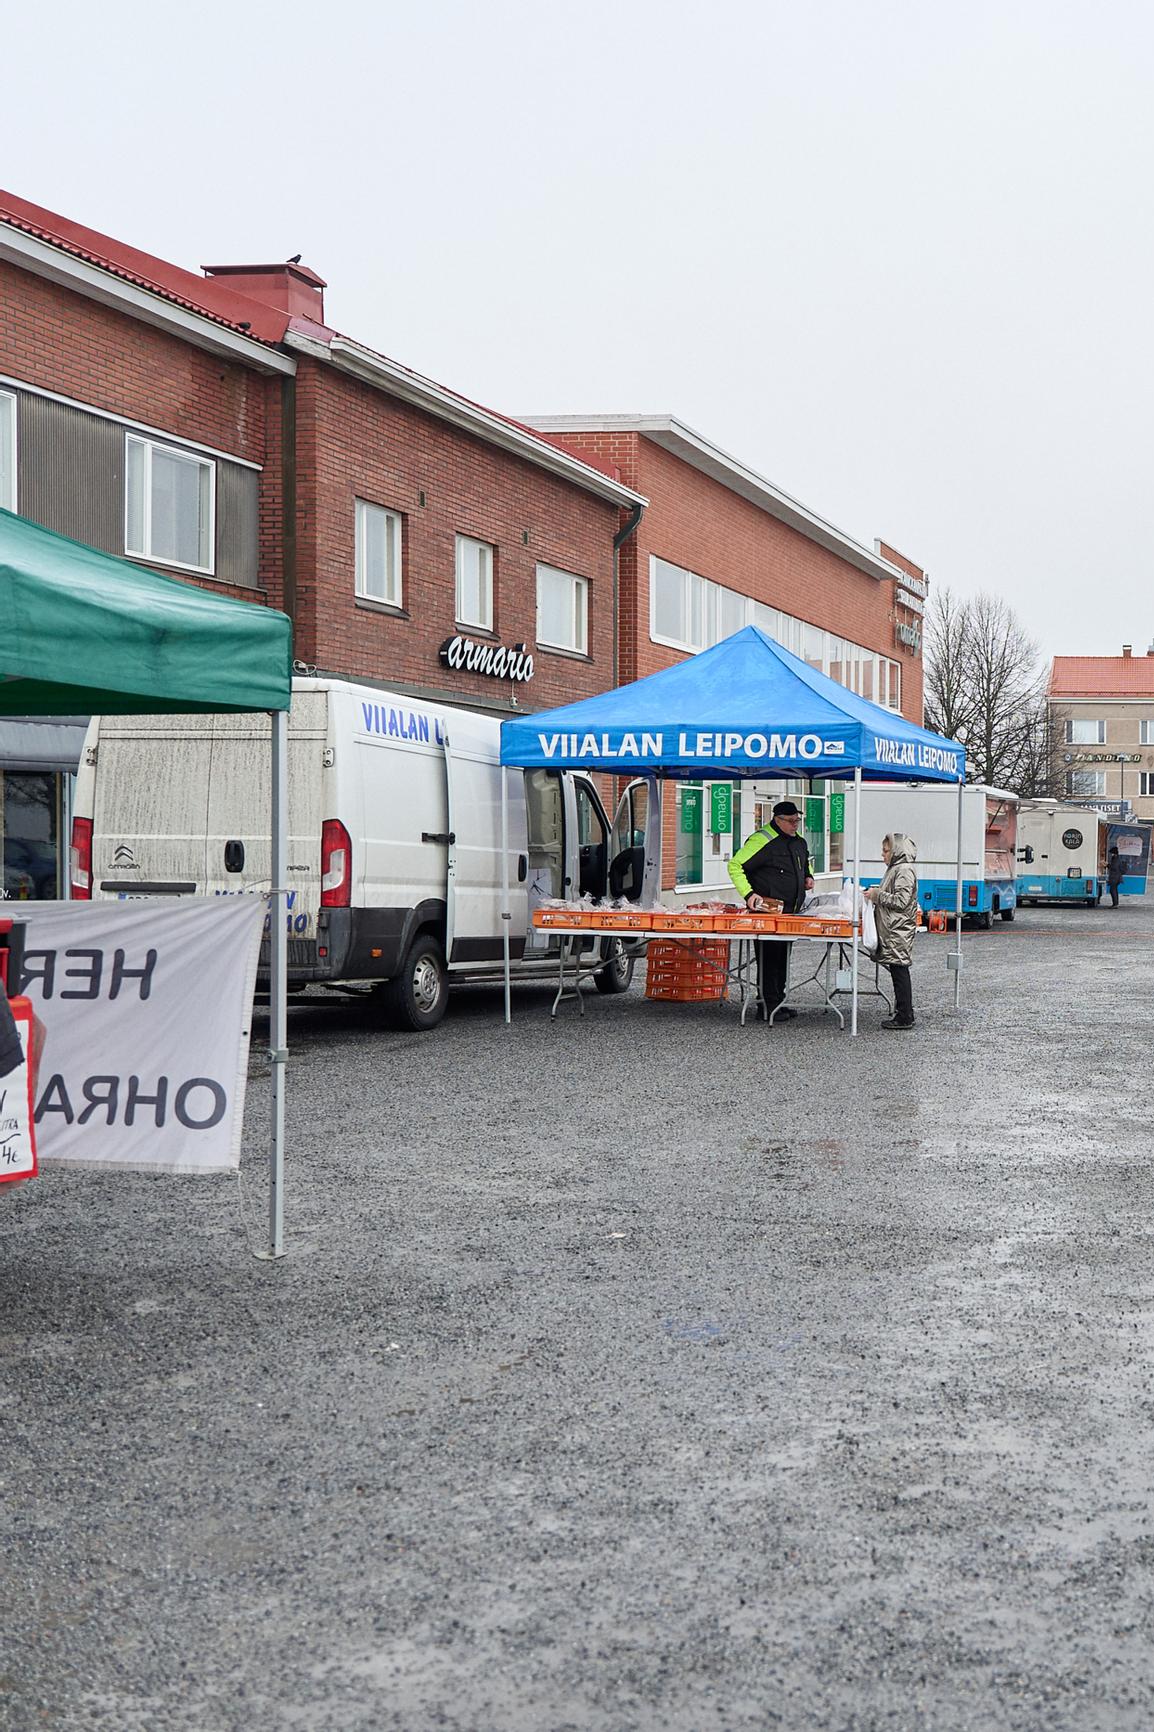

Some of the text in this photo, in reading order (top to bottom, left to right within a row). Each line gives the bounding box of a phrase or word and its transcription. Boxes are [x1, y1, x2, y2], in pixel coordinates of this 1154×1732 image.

[440, 635, 535, 682] armario
[361, 702, 430, 743] VIIALAN
[538, 733, 662, 758] VIIALAN
[678, 732, 824, 759] LEIPOMO
[874, 736, 957, 774] VIIALAN LEIPOMO
